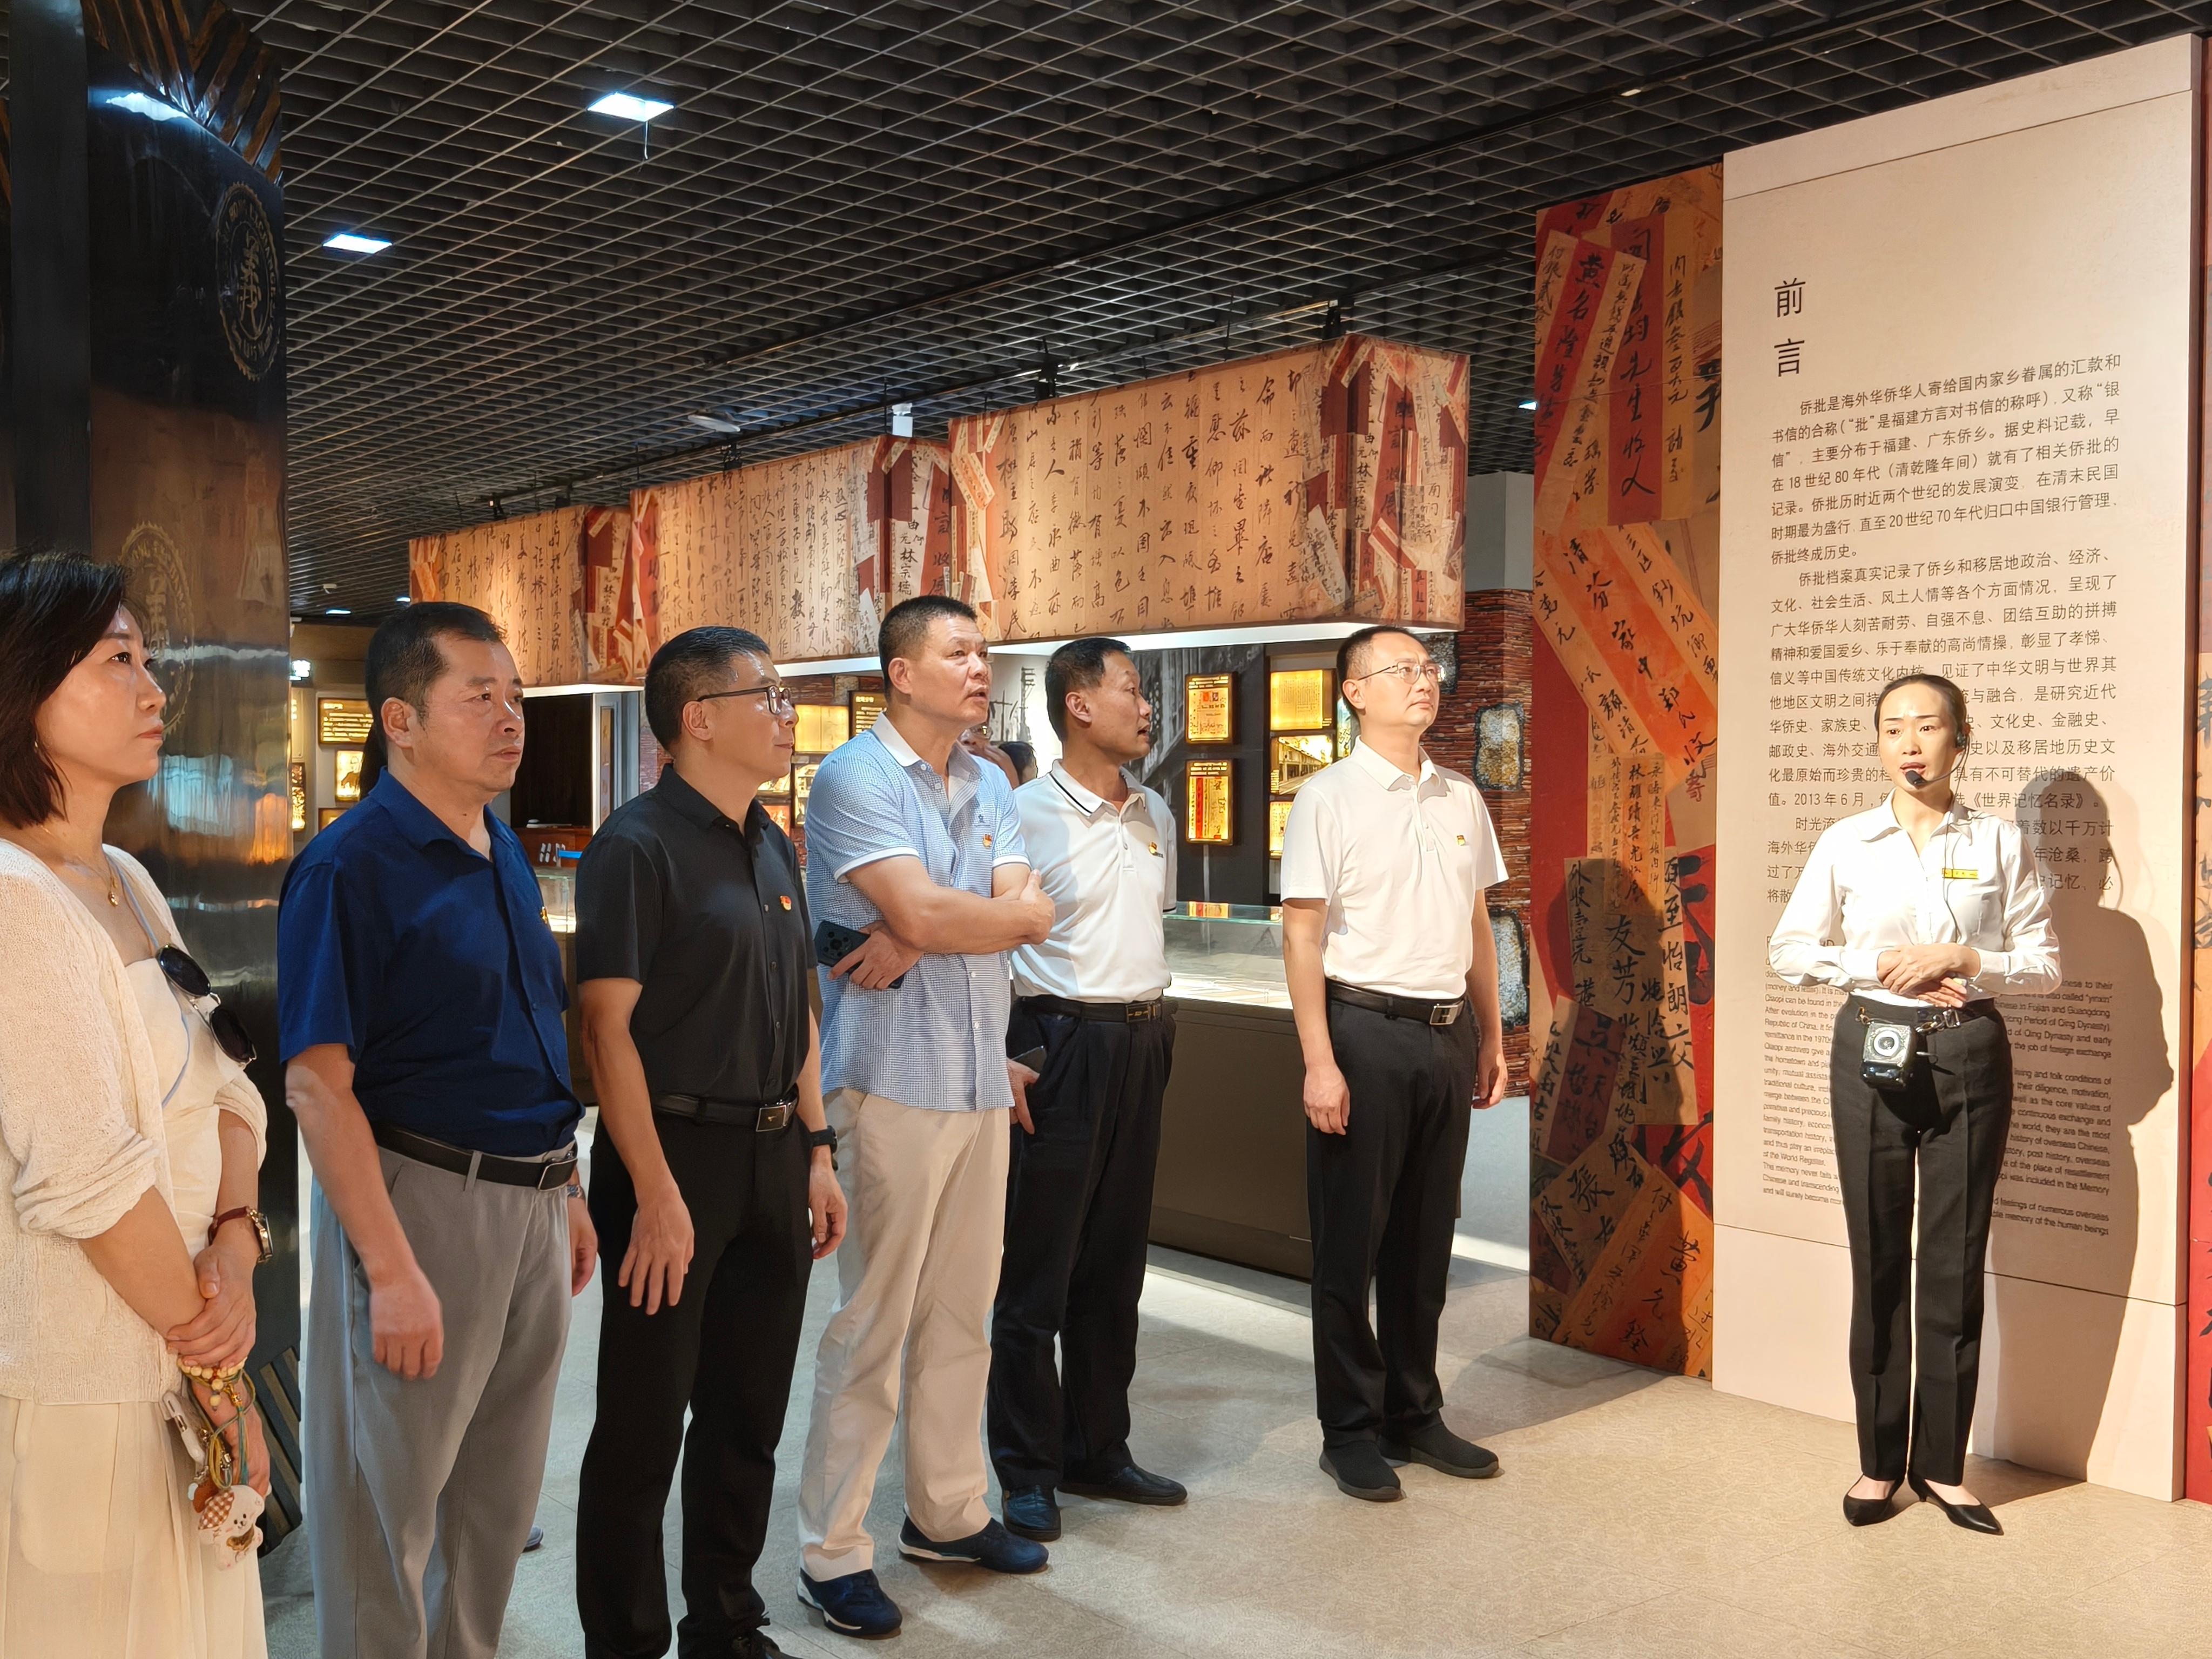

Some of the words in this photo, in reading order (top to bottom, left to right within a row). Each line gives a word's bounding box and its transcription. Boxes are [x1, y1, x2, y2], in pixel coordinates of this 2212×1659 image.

[1774, 278, 1806, 377] 前言
[1800, 354, 2121, 415] 侨批是海外华侨华人寄给国内家乡眷属的汇款和
[1771, 544, 1857, 565] 侨批终成历史。
